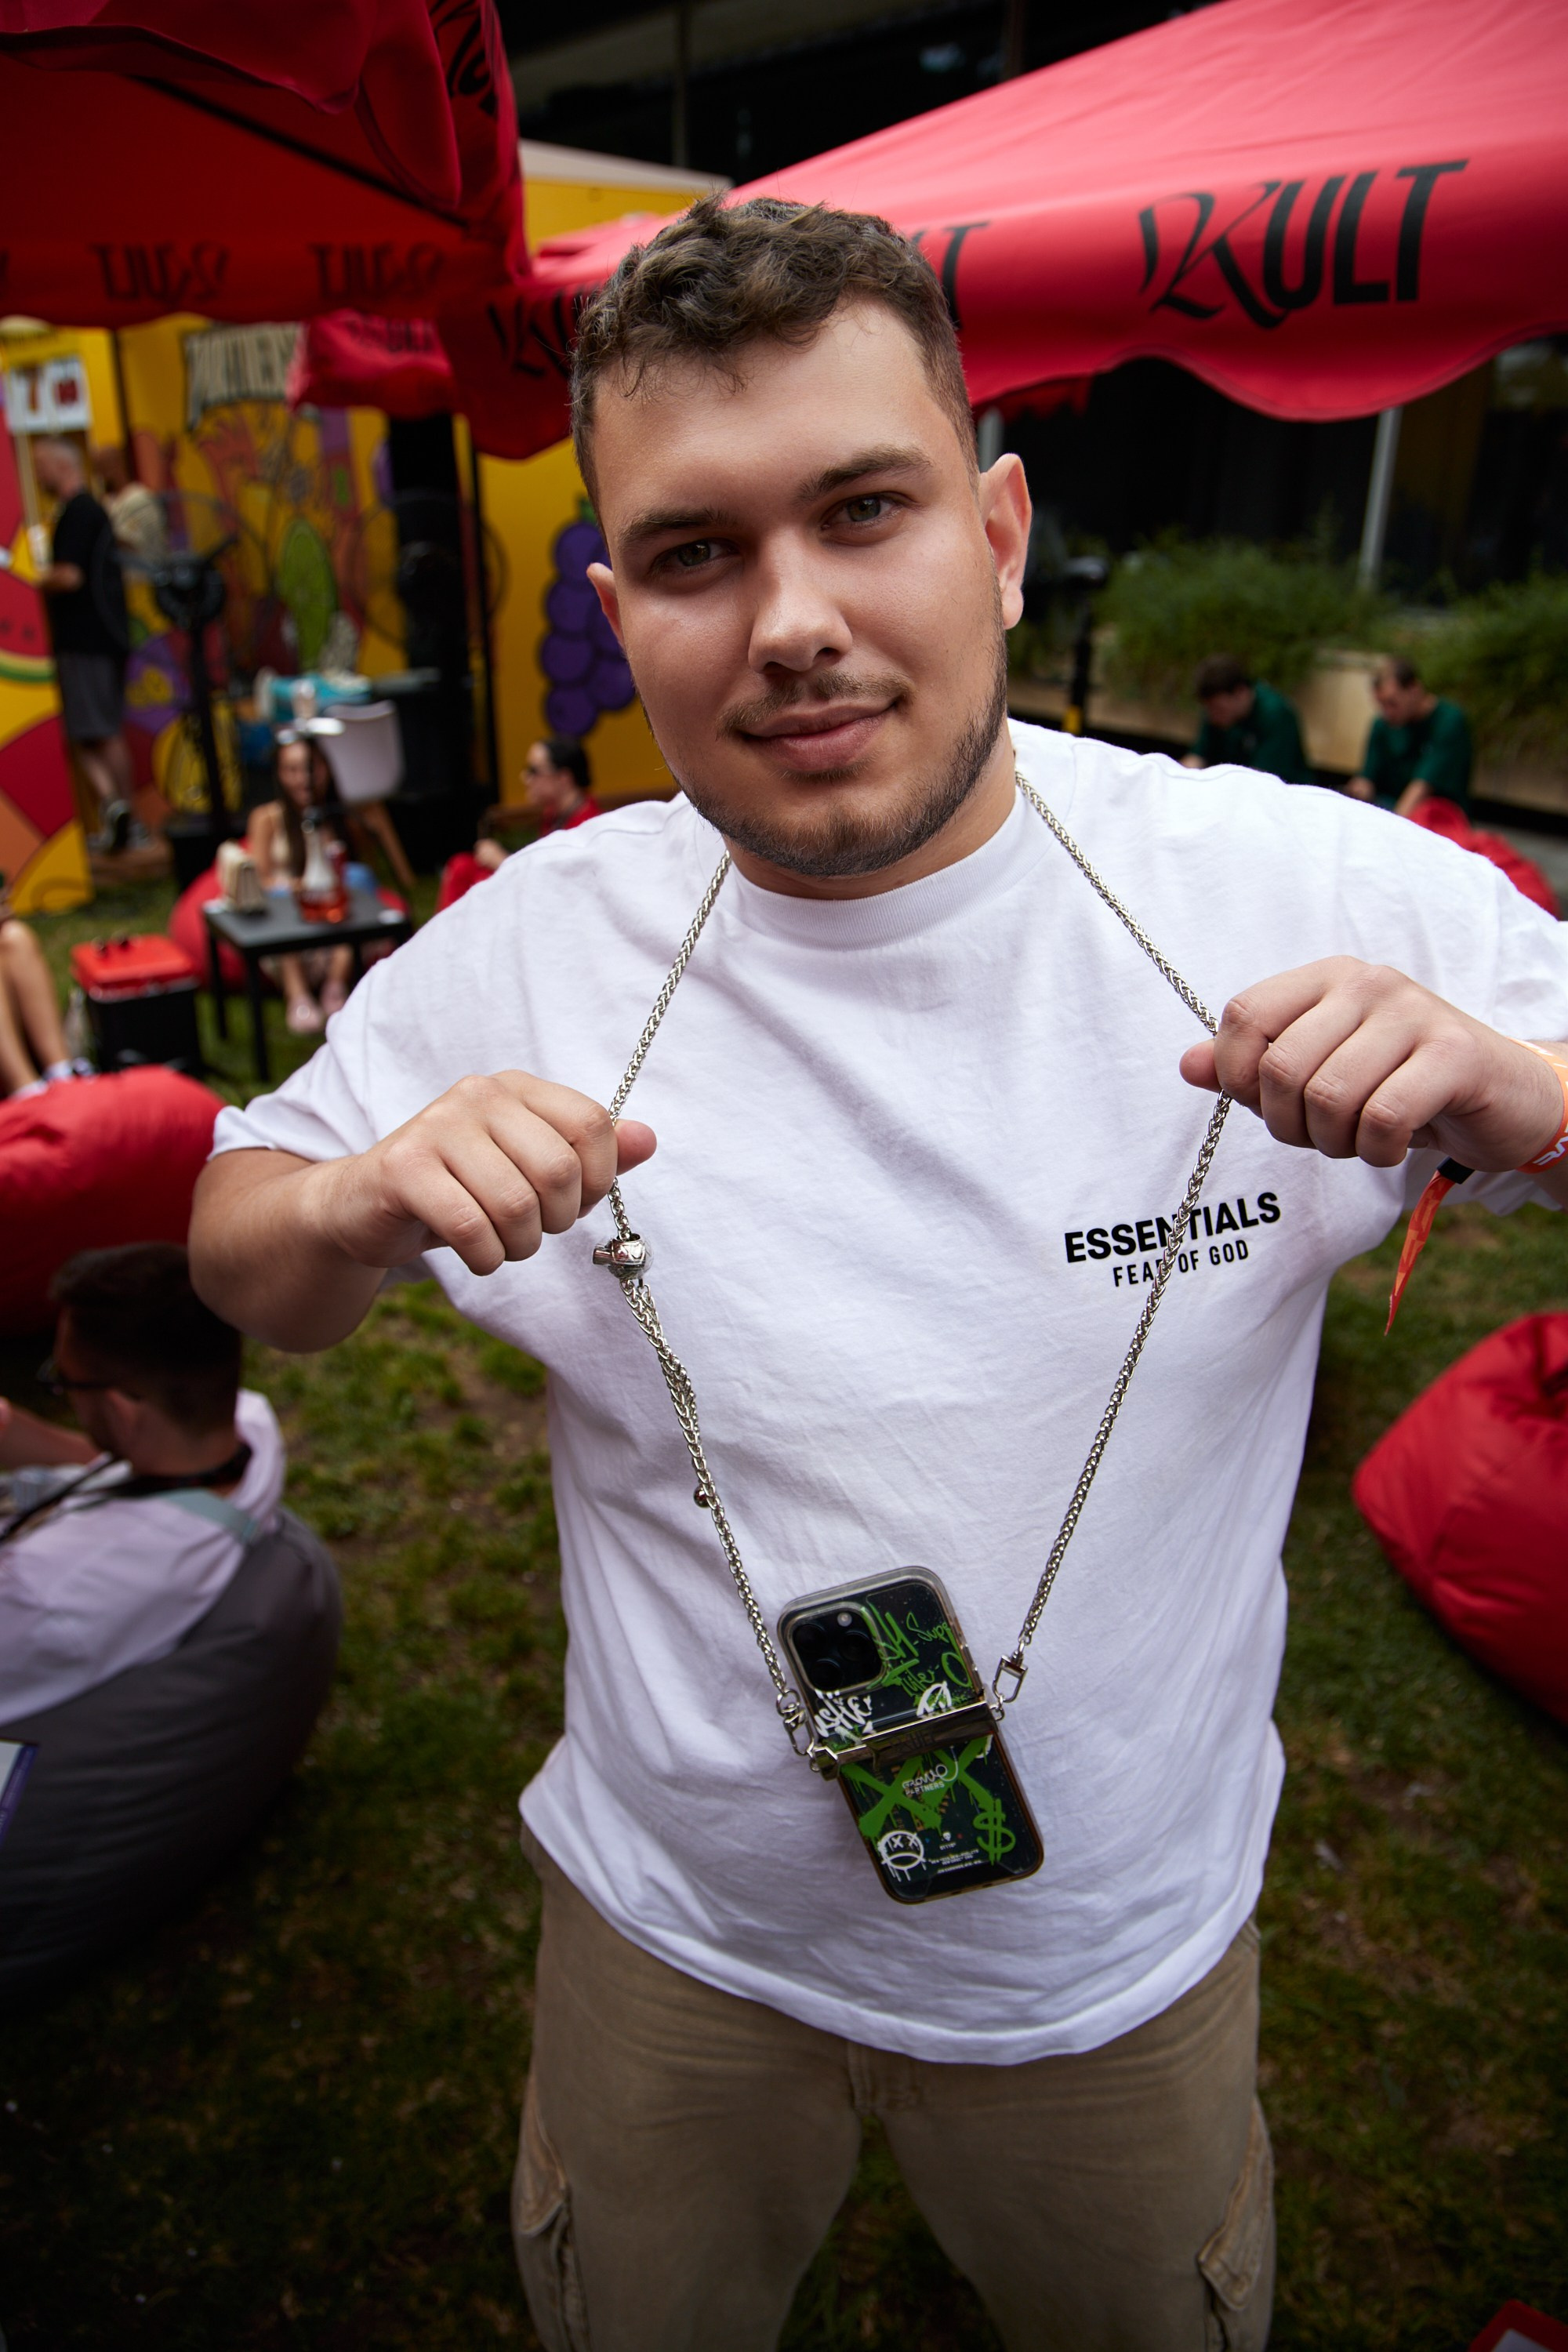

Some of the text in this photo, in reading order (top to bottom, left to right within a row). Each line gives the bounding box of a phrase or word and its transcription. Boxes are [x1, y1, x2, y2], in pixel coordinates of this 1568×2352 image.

[1138, 159, 1470, 329] KULT
[1178, 1250, 1200, 1273] OF
[1209, 1240, 1249, 1265] GOD
